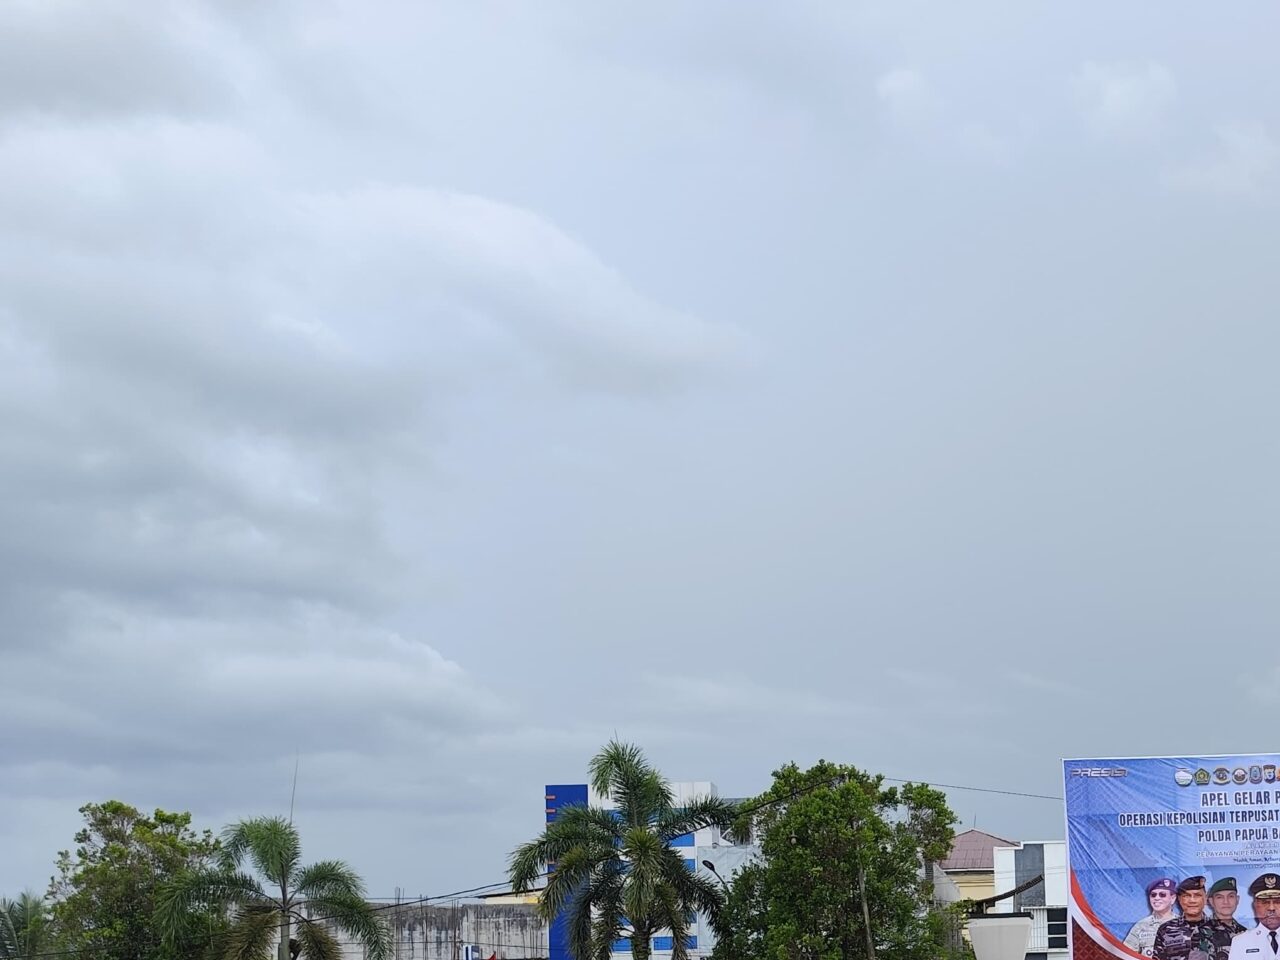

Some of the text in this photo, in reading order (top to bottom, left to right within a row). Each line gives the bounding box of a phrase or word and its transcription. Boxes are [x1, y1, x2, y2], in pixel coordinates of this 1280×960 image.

[1071, 767, 1128, 777] PRESISI
[1201, 792, 1230, 807] APEL
[1234, 790, 1270, 805] GELAR
[1119, 813, 1163, 826] OPERASI
[1166, 811, 1226, 825] KEPOLISIAN
[1229, 809, 1280, 823] TERPUSAT
[1198, 829, 1232, 842] POLDA
[1235, 828, 1269, 841] PAPUA
